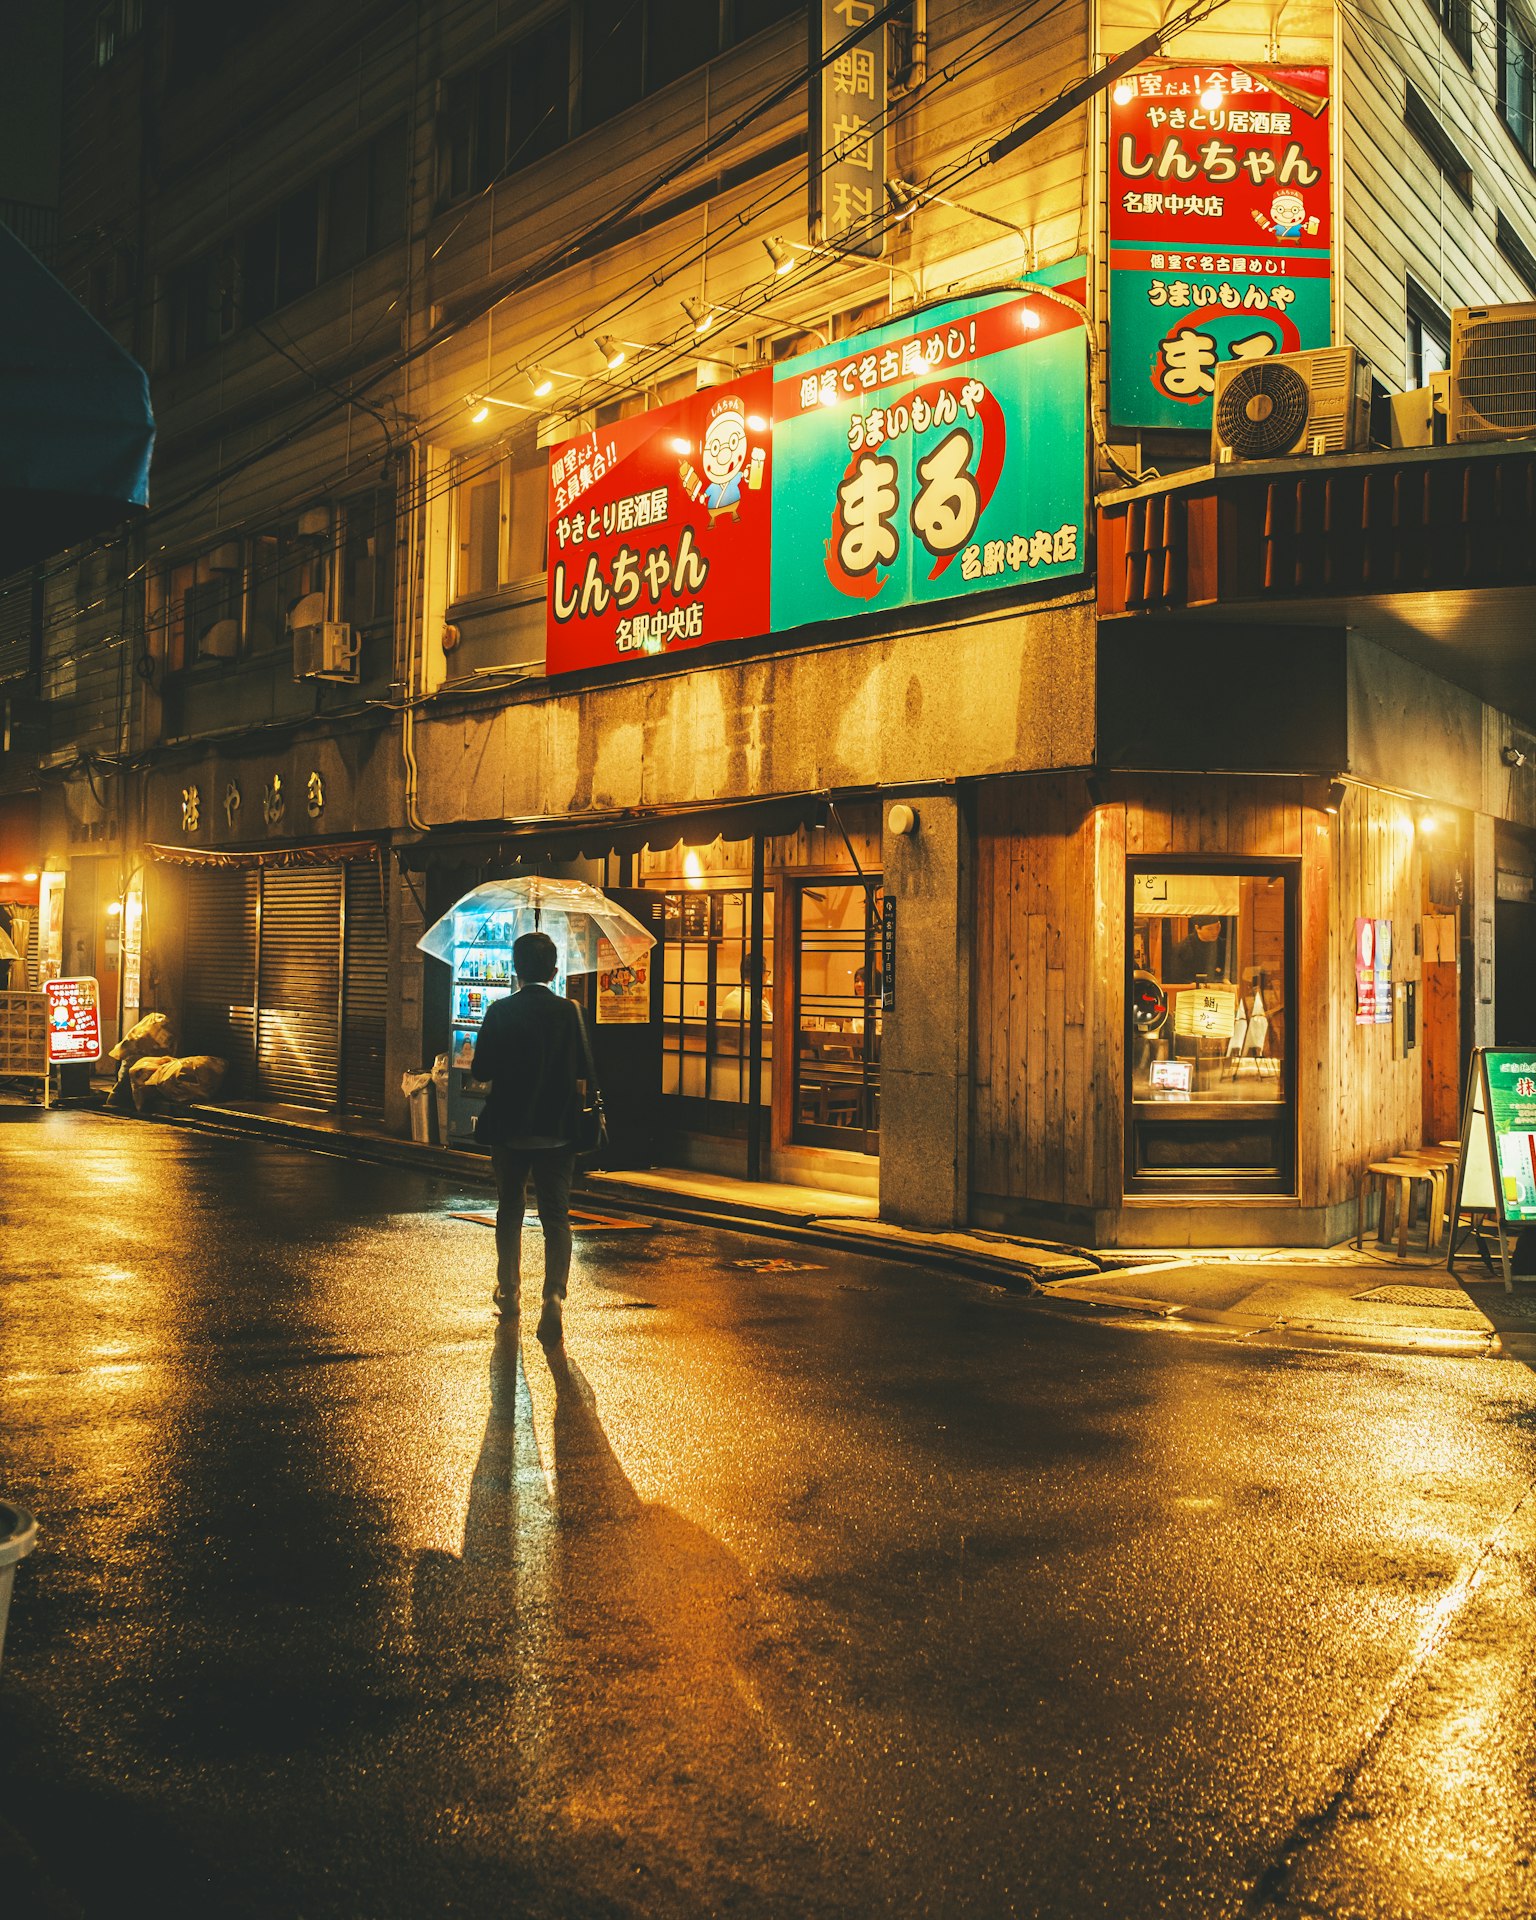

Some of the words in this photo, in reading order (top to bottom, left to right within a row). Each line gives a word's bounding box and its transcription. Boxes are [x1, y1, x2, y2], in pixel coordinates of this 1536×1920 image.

[1146, 106, 1292, 135] やきとり居酒屋
[1119, 135, 1320, 187] しんちゃん
[1122, 191, 1224, 217] 名駅中央店
[1150, 254, 1286, 274] 個室で名古屋めし!
[1148, 279, 1296, 311] うまいもんや
[800, 320, 977, 409] 個室で名古屋めし!
[711, 398, 739, 418] しんちゃん
[847, 378, 986, 452] うまいもんや
[552, 431, 598, 489] 個室だよ!
[555, 441, 617, 515] 全員集合!!
[555, 487, 669, 549] やきとり居酒屋
[837, 427, 981, 577] まる
[553, 525, 709, 624] しんちゃん
[960, 524, 1078, 582] 名駅中央店
[615, 603, 704, 653] 名駅中央店
